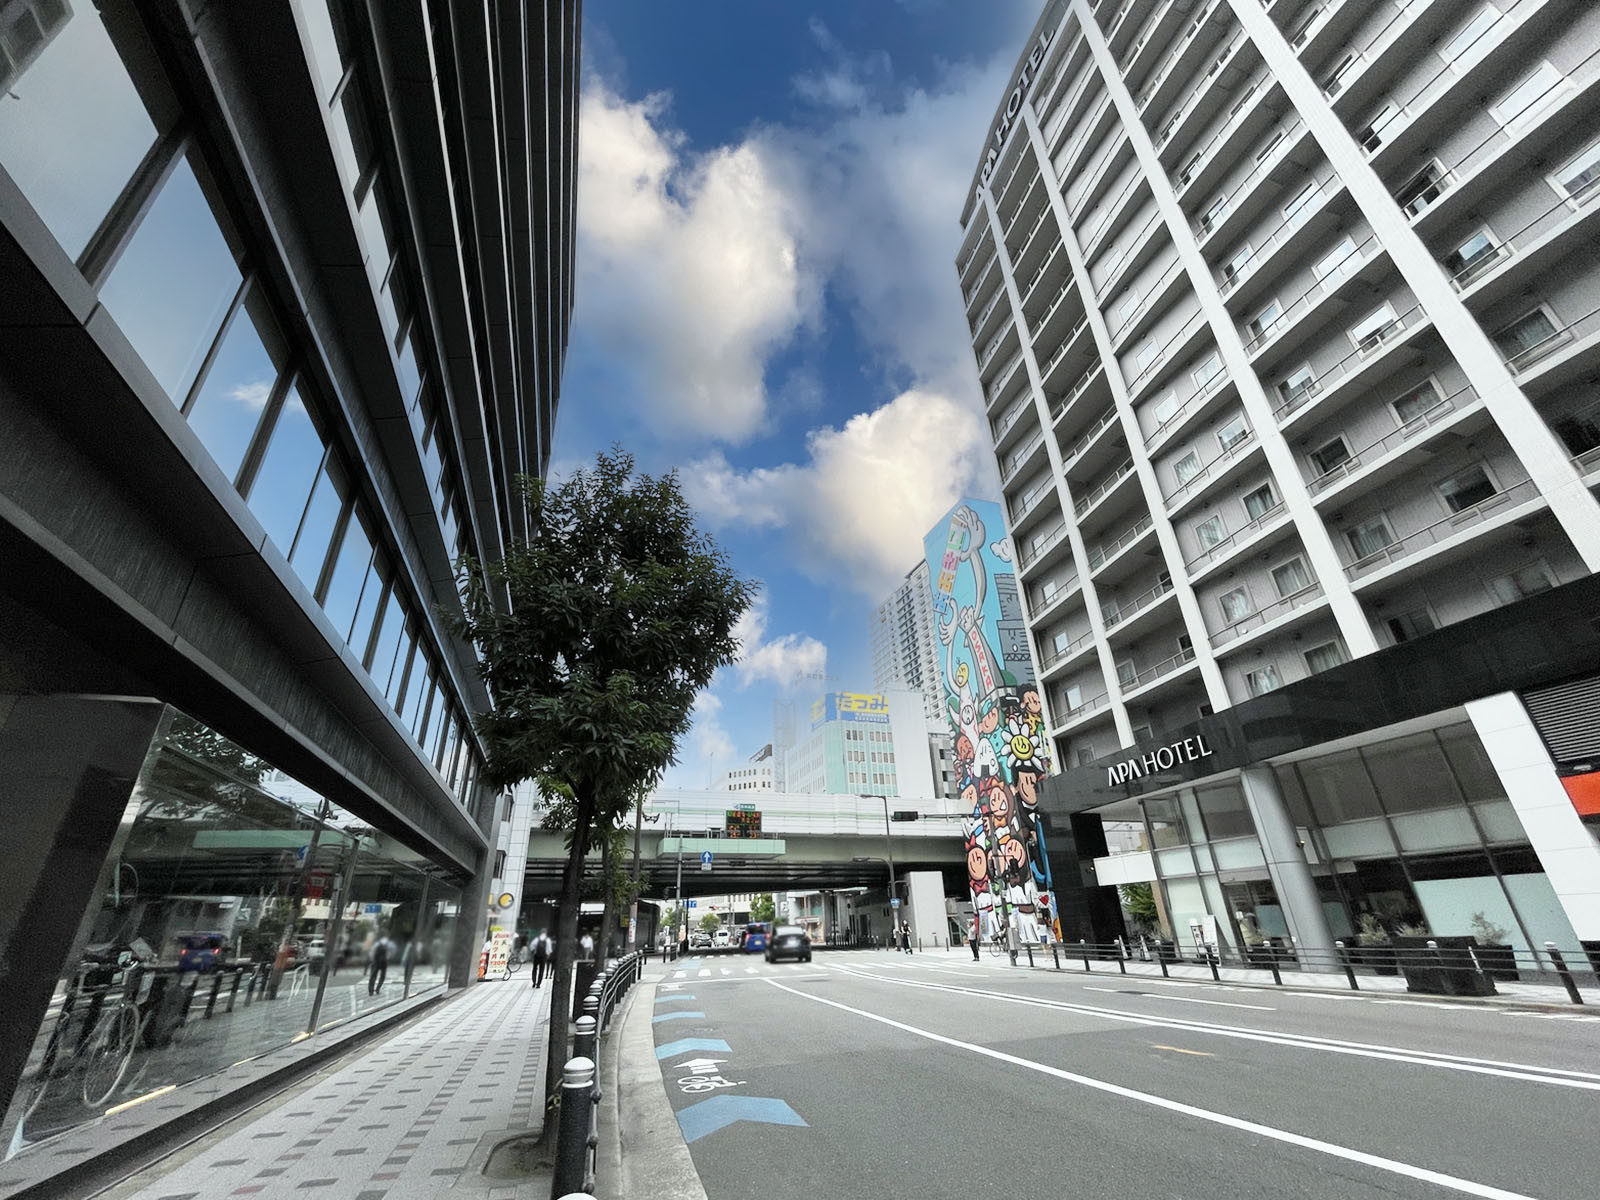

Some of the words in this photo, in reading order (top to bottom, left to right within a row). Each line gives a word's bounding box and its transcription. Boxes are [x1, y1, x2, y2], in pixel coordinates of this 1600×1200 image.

[975, 147, 1000, 203] APA
[996, 29, 1056, 146] HOTEL
[971, 629, 993, 692] OSAKA
[835, 693, 889, 711] たつみ
[1107, 759, 1142, 787] APA
[1143, 734, 1213, 775] HOTEL
